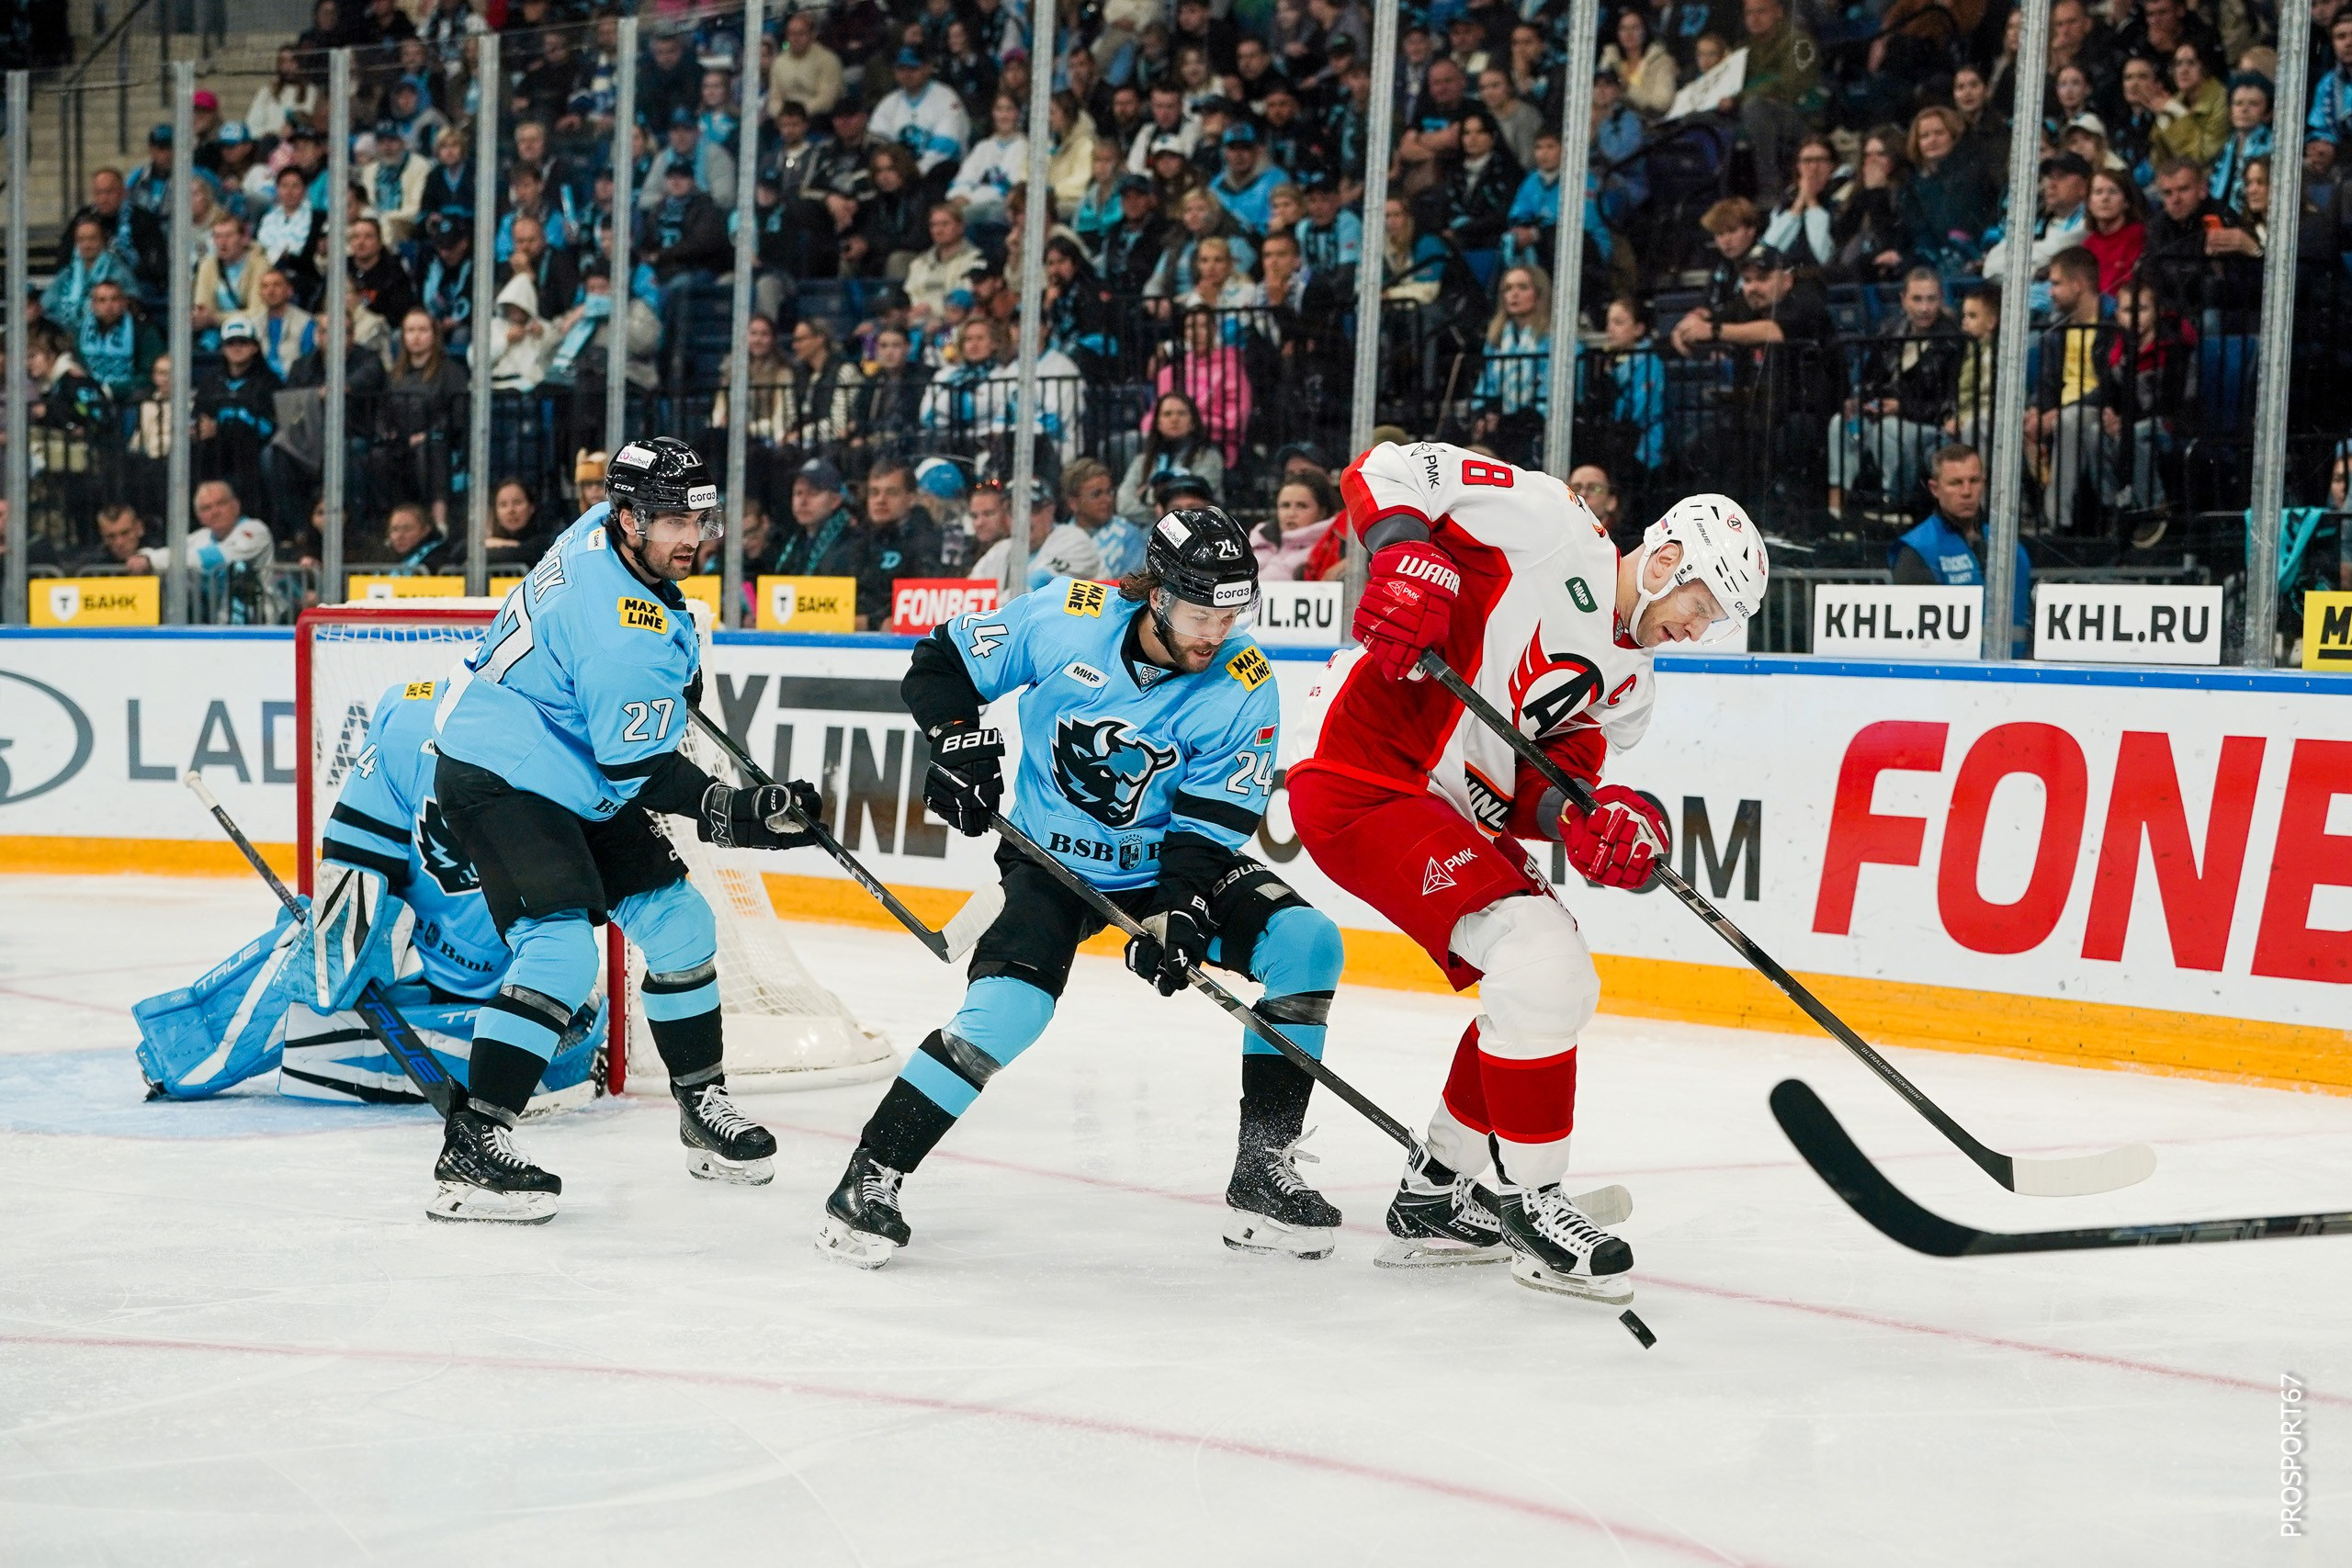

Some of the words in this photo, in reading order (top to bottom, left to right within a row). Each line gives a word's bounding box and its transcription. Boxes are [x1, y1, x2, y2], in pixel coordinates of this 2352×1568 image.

[614, 482, 636, 492] CCM
[1461, 459, 1514, 488] 8
[1215, 539, 1239, 558] 24
[1396, 555, 1461, 597] WARR
[84, 594, 139, 612] БАНК
[625, 599, 659, 616] MAX
[797, 596, 838, 614] БАНК
[893, 588, 998, 626] FONBET
[1068, 581, 1089, 611] LINE
[1085, 584, 1105, 612] MAX
[1216, 587, 1250, 600] согаз
[628, 613, 663, 630] LINE
[1257, 597, 1333, 628] L.RU
[1825, 604, 1971, 639] KHL.RU
[2047, 604, 2210, 644] KHL.RU
[474, 581, 535, 685] 7
[1232, 649, 1261, 675] MAX
[1246, 661, 1270, 686] LINE
[1608, 673, 1636, 706] C
[621, 697, 676, 743] 27
[1225, 750, 1274, 797] 24
[770, 788, 778, 811] CCM
[1046, 831, 1114, 863] BSB
[836, 852, 884, 904] CCM
[195, 940, 261, 991] TRUE
[439, 939, 494, 973] Bank
[1860, 1047, 1894, 1076] ULTRALOW
[1892, 1073, 1924, 1102] KICKPOINT
[1371, 1112, 1403, 1139] ULTRALOW
[1448, 1219, 1477, 1237] CCM
